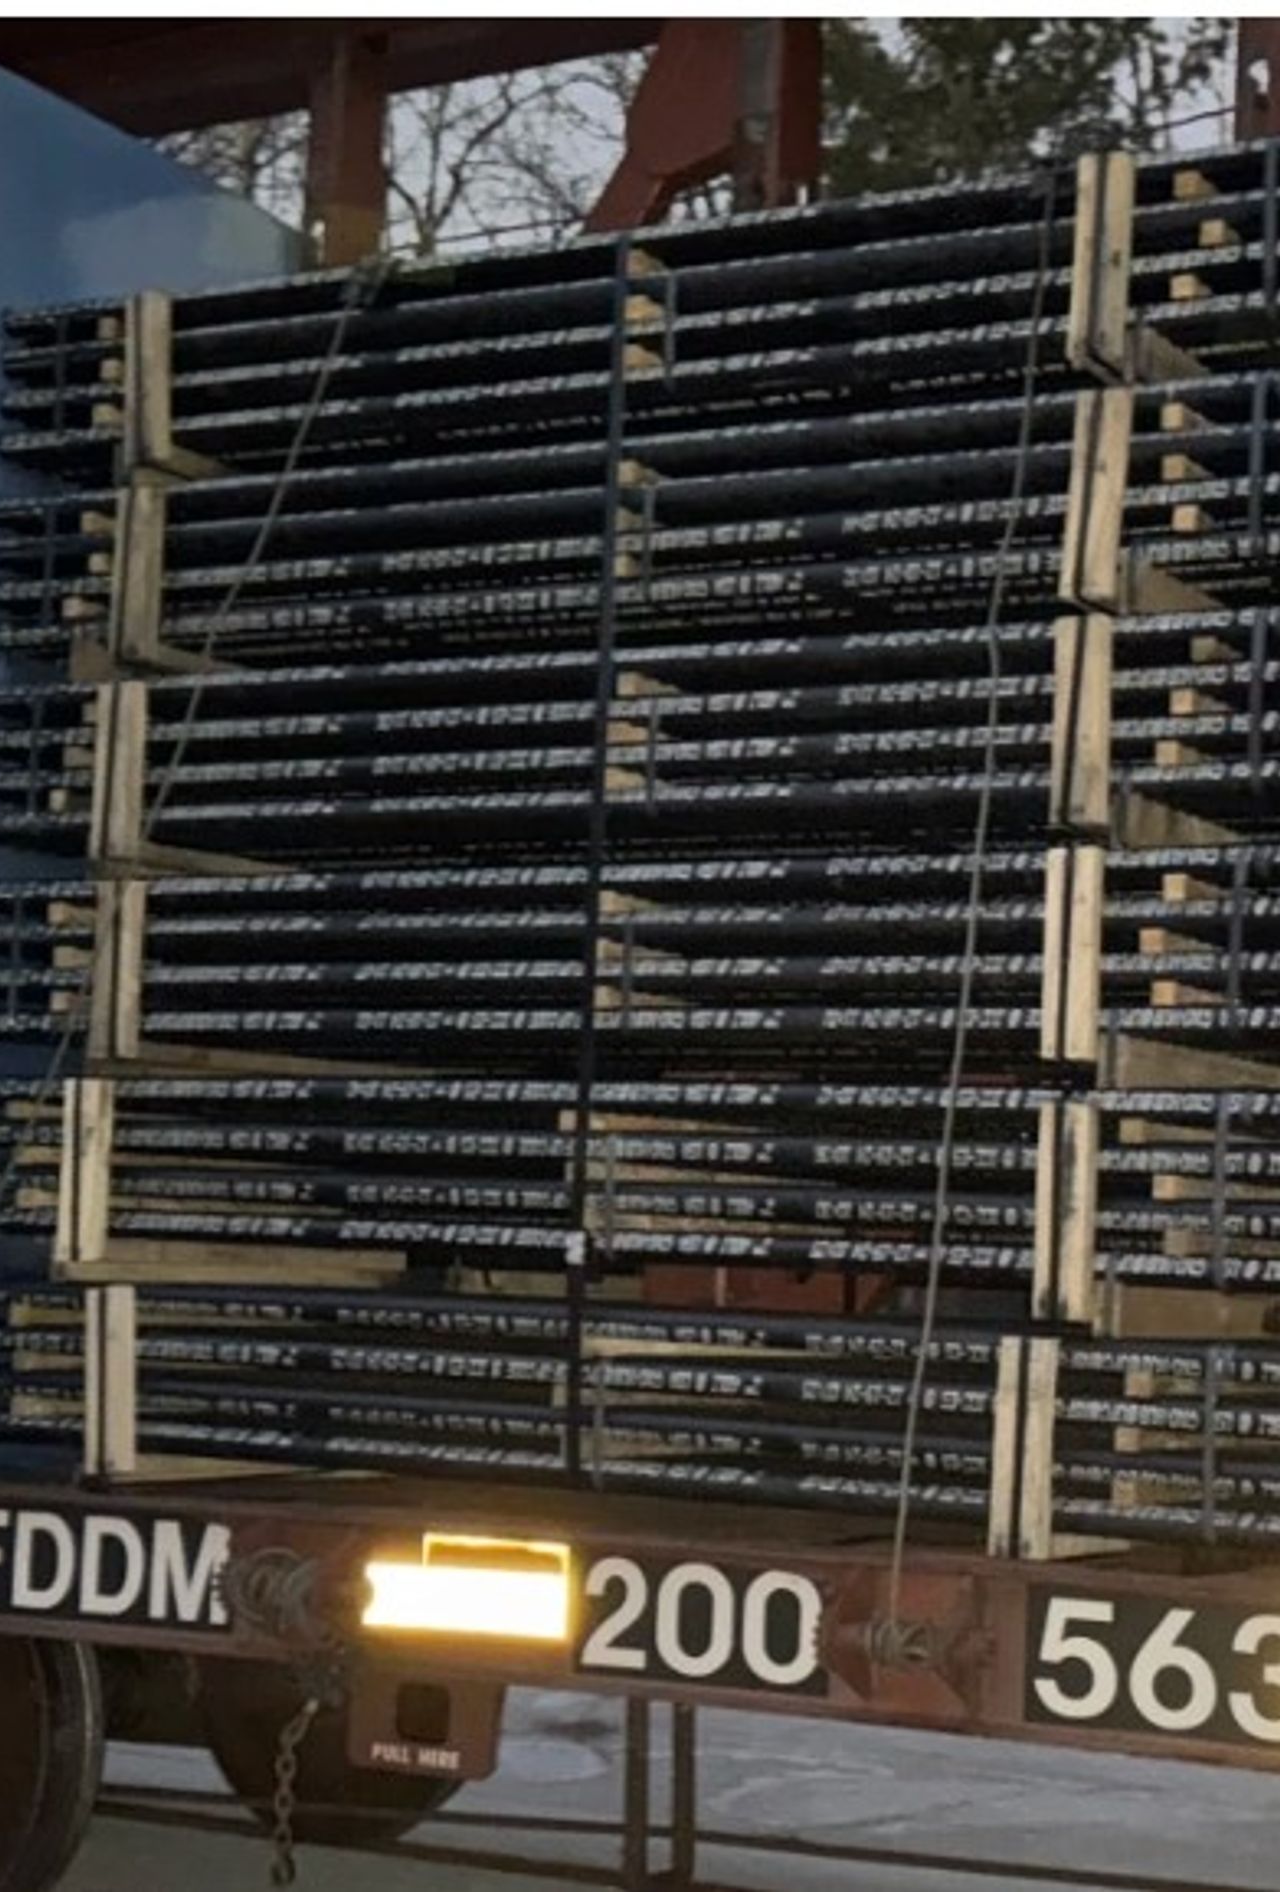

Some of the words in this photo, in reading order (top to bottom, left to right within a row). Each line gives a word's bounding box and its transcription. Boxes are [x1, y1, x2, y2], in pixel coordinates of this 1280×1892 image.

[579, 1556, 821, 1685] 200
[370, 1742, 411, 1764] PULL
[417, 1748, 460, 1769] HERE
